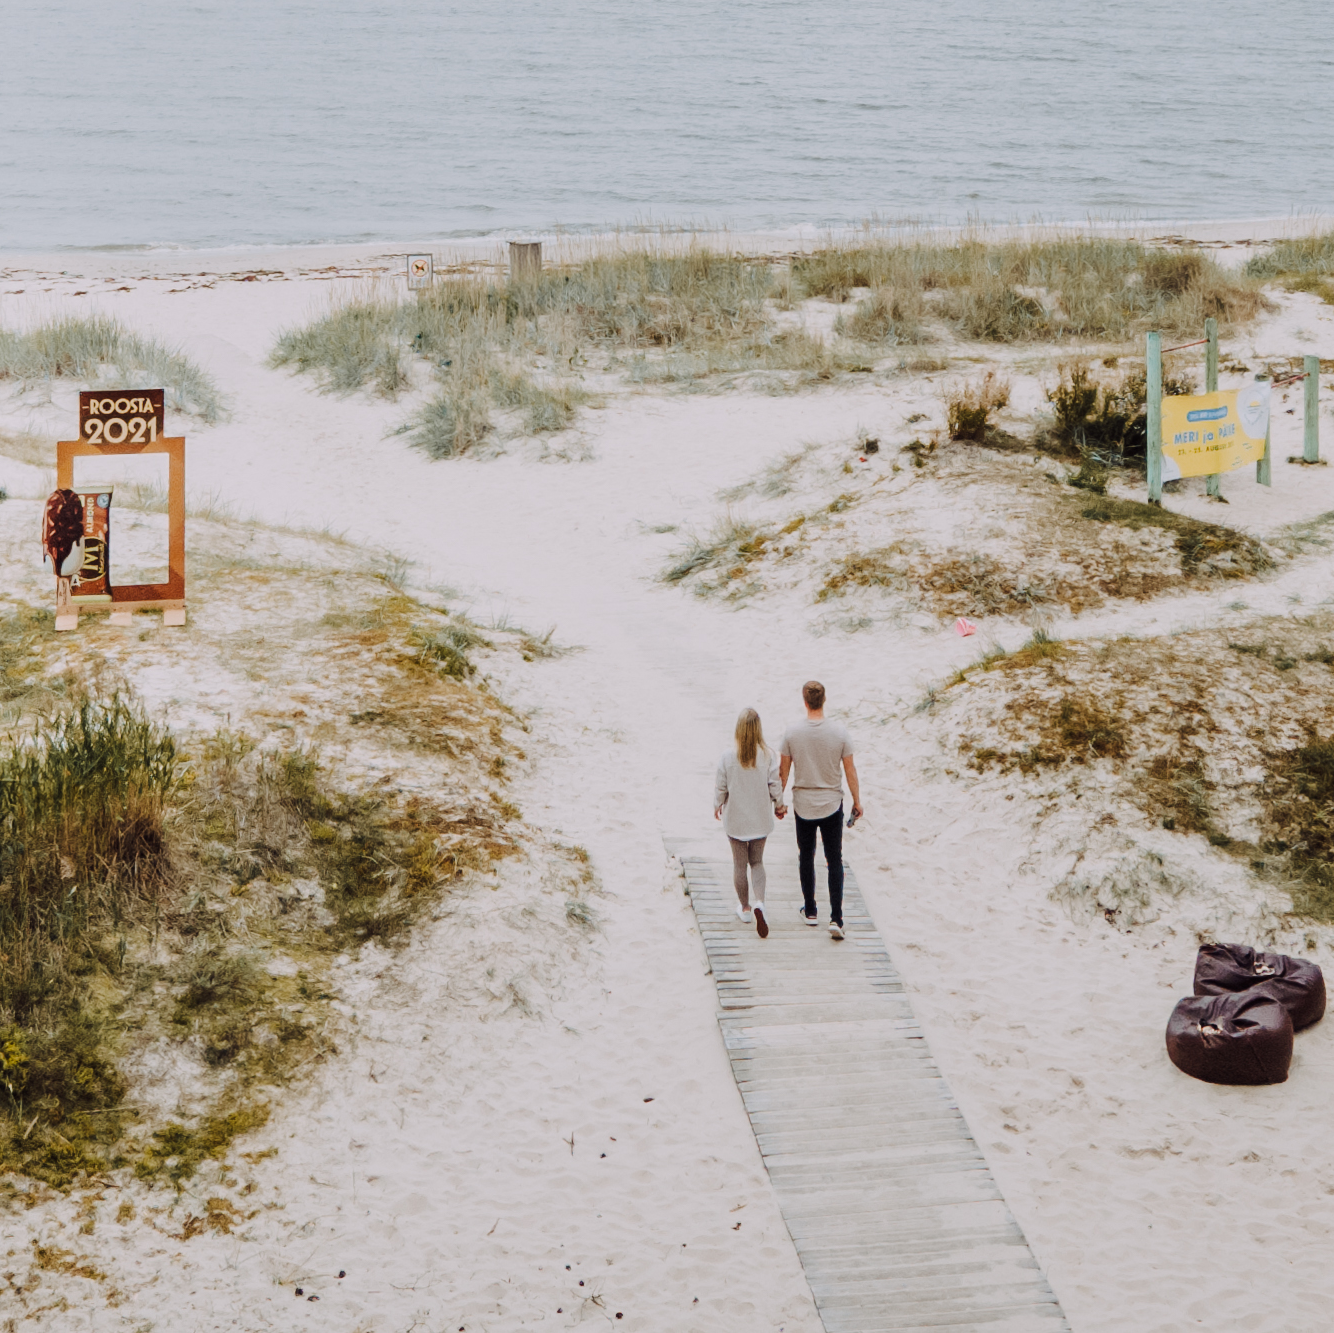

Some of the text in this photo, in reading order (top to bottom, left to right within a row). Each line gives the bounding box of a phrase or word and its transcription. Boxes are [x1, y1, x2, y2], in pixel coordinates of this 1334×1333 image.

[84, 416, 157, 444] 2021
[1174, 431, 1198, 444] MERI
[1219, 423, 1234, 438] PÄE
